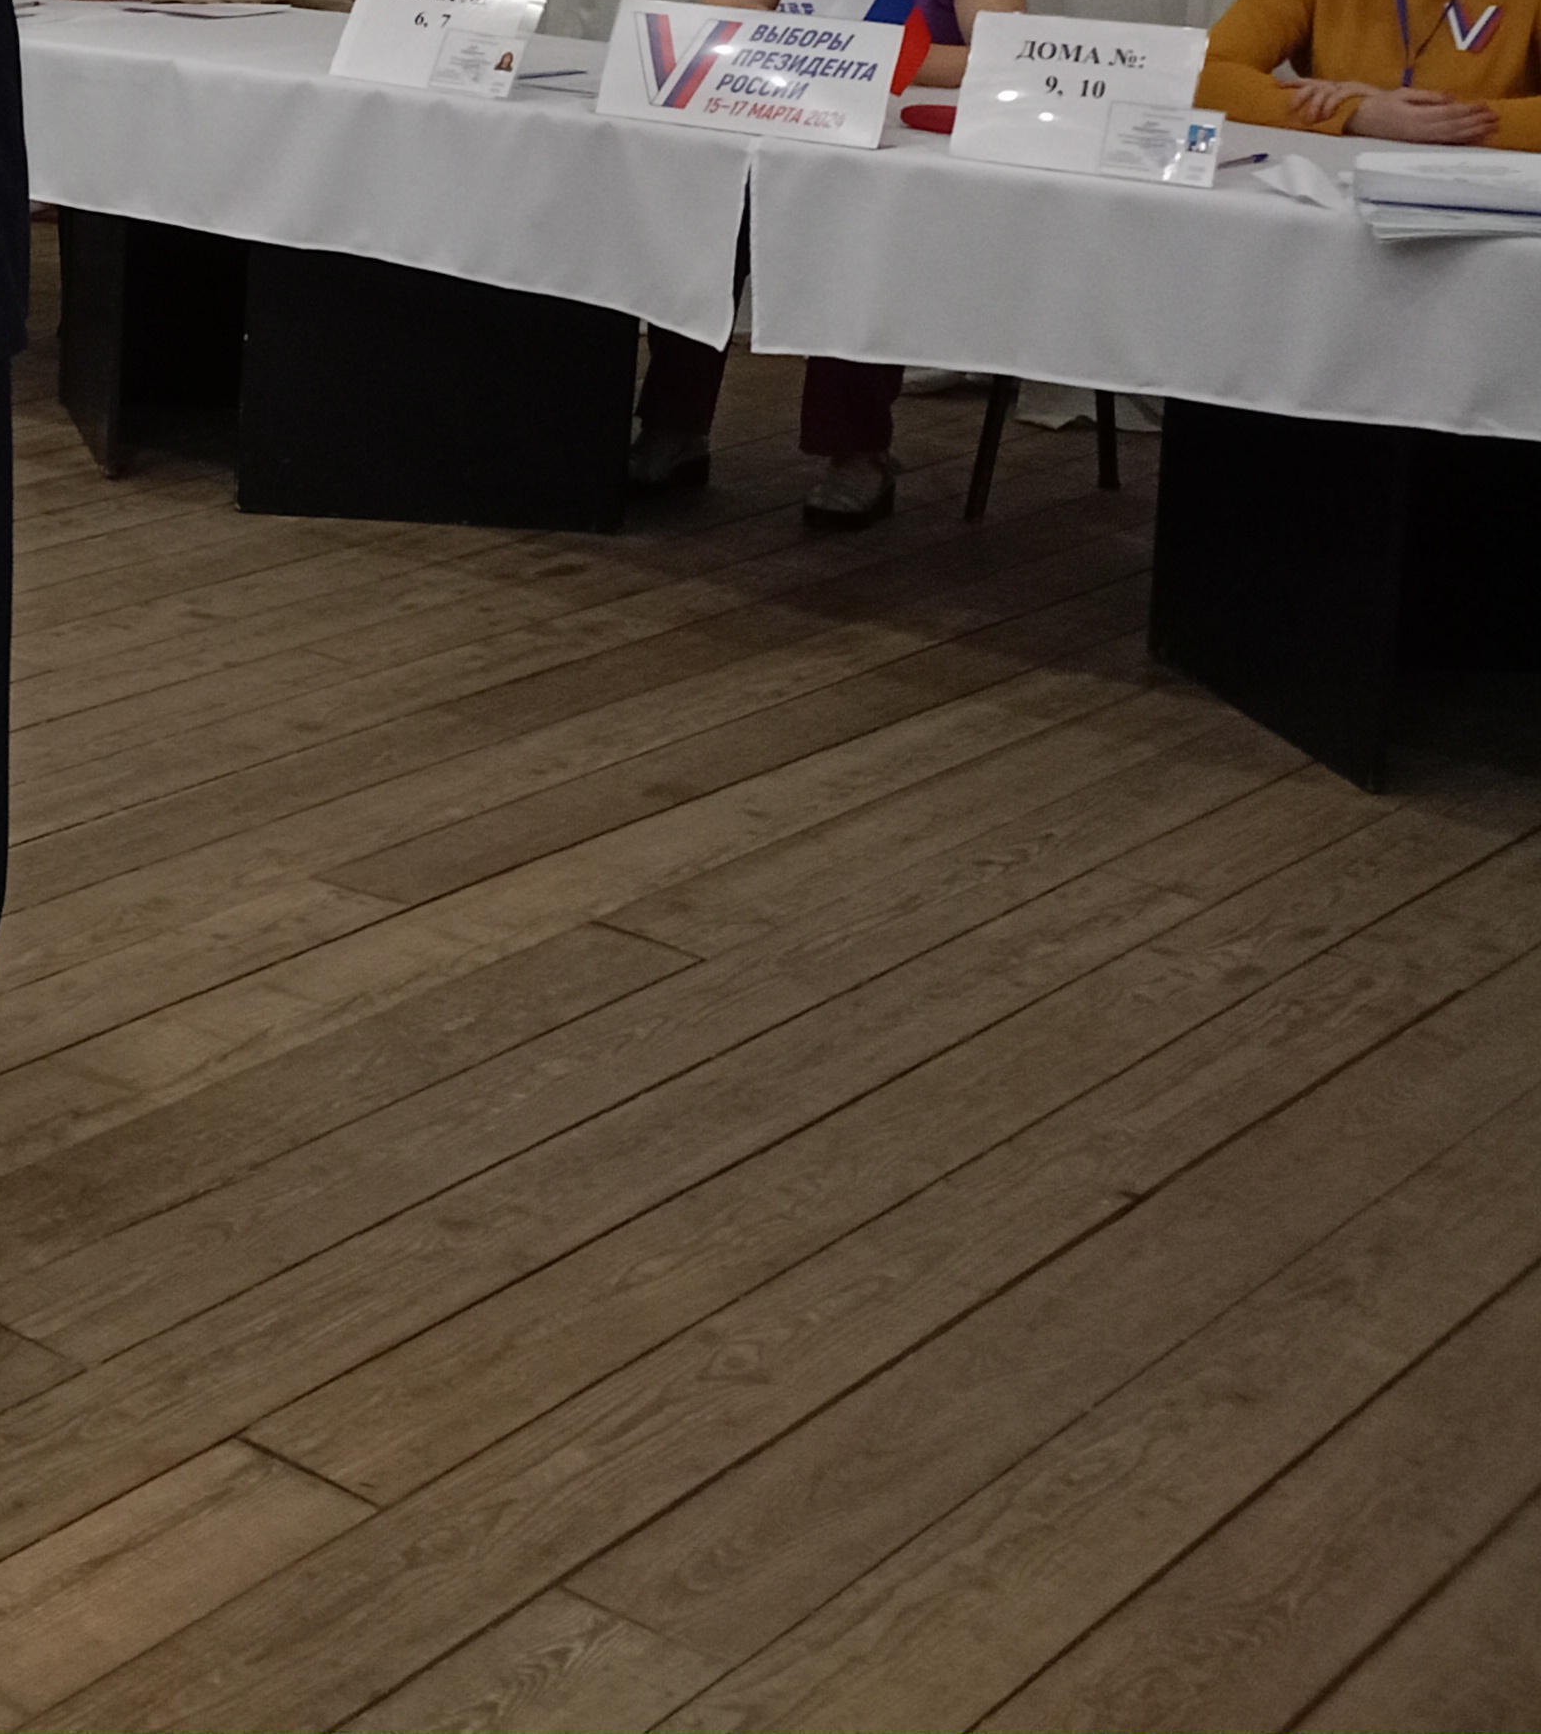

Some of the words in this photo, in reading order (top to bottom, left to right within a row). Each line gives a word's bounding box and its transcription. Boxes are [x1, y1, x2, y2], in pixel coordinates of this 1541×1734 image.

[414, 11, 428, 27] 6,
[440, 13, 451, 28] 7
[749, 24, 854, 52] ВЫБОРЫ
[732, 48, 878, 82] ПРЕЗИДЕНТА
[1016, 39, 1101, 65] ДОМА
[1045, 75, 1064, 97] 9,
[1079, 78, 1106, 99] 10
[748, 103, 802, 124] МАРТА
[803, 109, 845, 129] 2024
